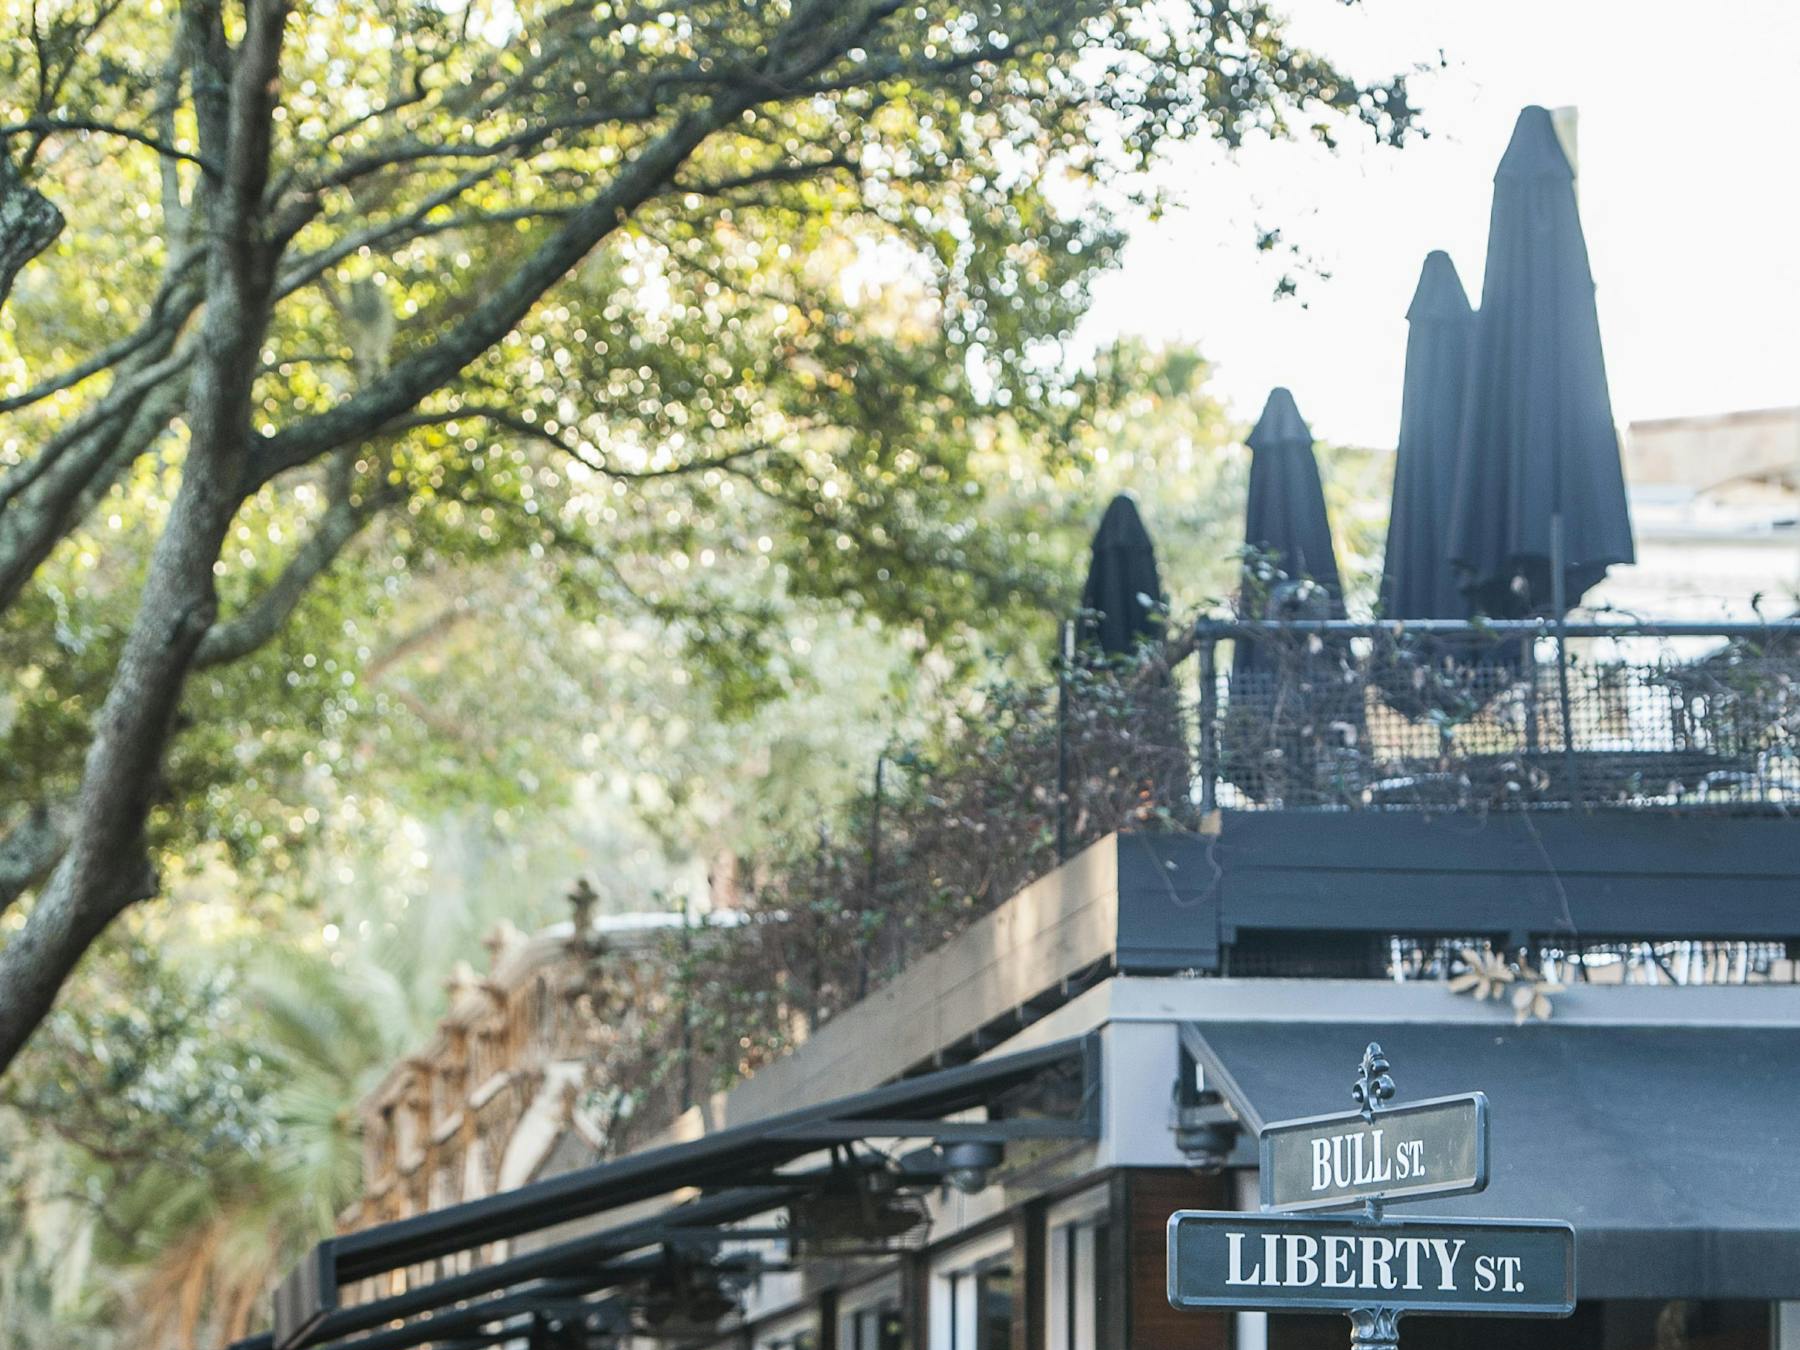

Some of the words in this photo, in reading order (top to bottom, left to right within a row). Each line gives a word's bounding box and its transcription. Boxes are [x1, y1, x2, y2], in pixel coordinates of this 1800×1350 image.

[1311, 1130, 1391, 1191] BULL
[1396, 1140, 1425, 1180] ST.
[1225, 1233, 1465, 1291] LIBERTY
[1474, 1256, 1525, 1293] ST.
